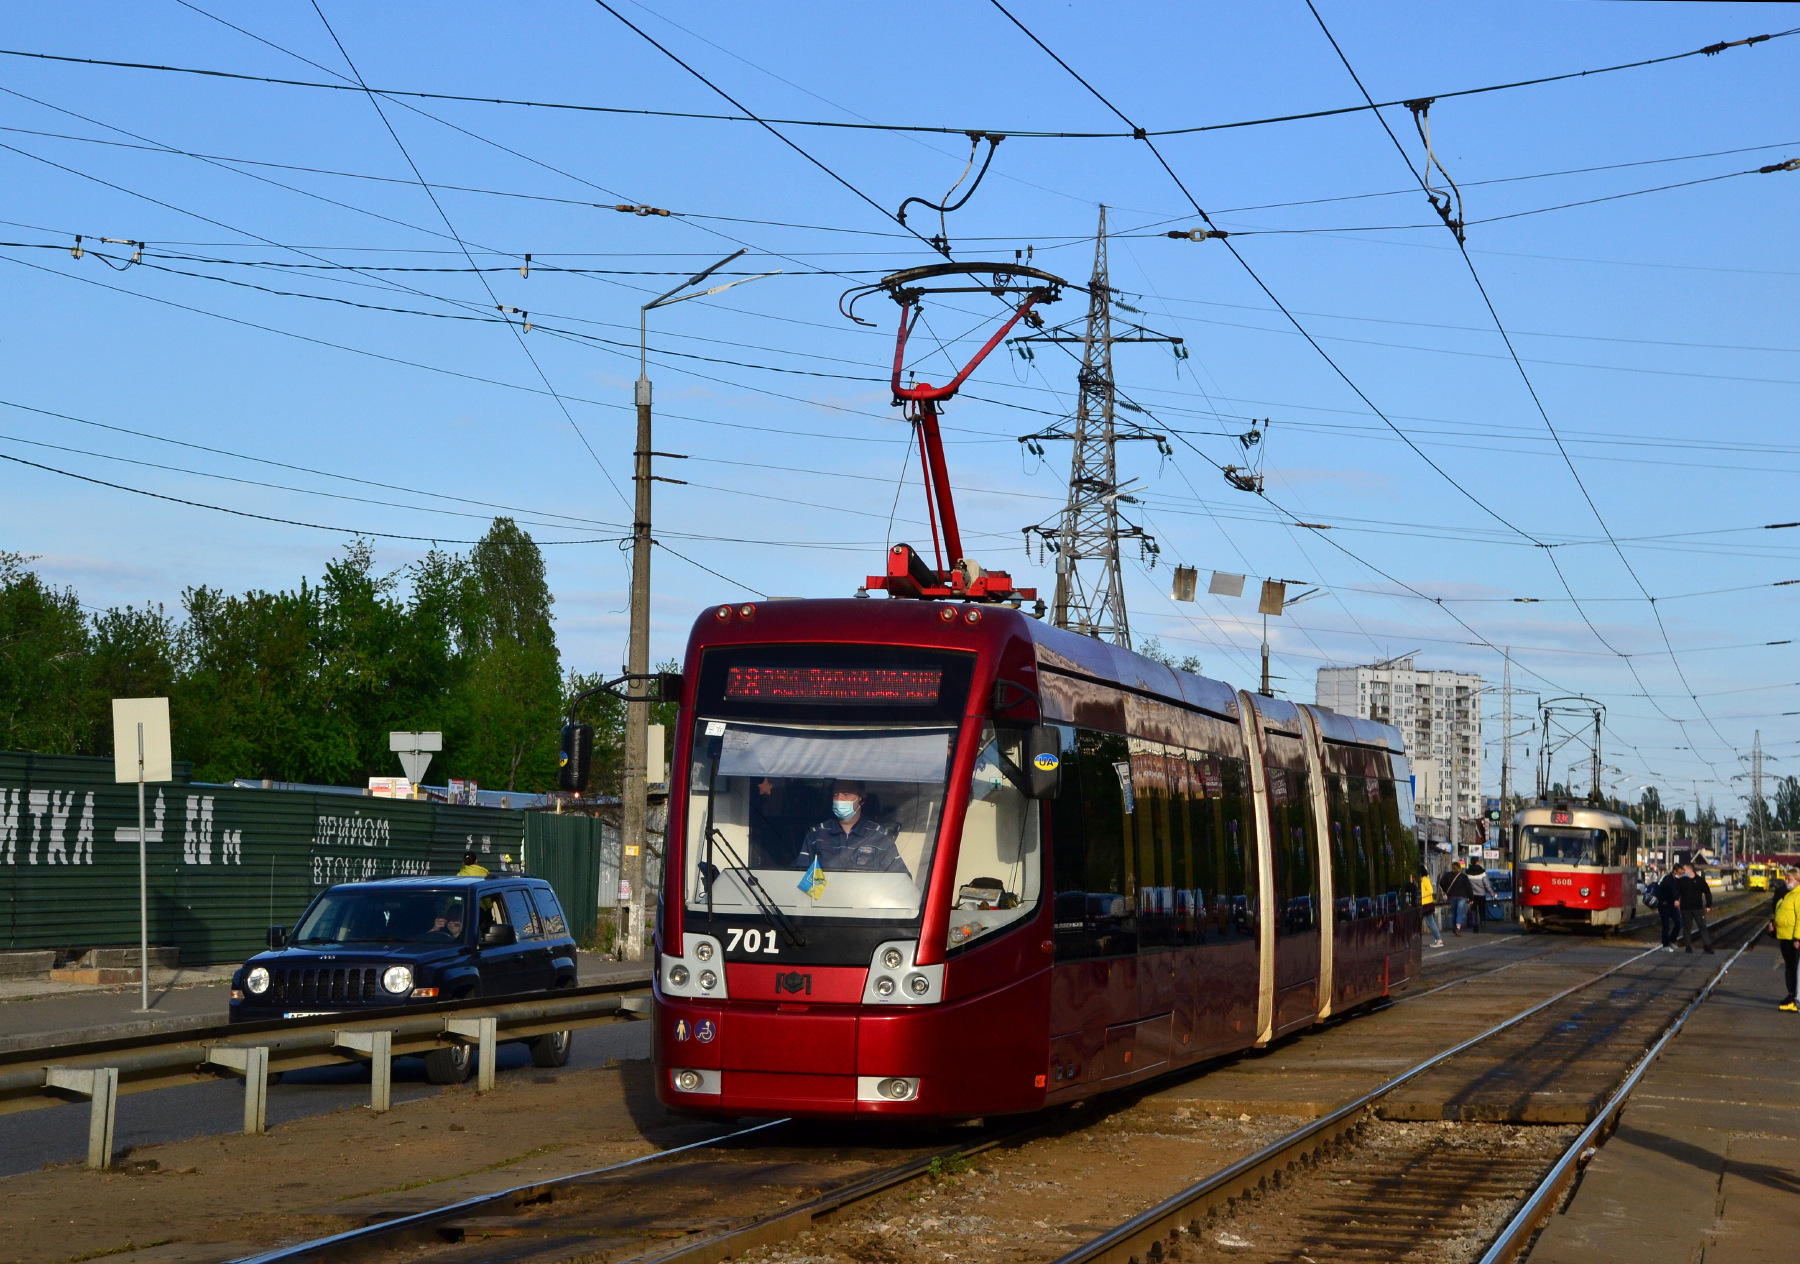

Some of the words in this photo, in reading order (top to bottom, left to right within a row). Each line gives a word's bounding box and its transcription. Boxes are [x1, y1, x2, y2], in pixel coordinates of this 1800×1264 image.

[1039, 757, 1053, 766] UA
[316, 810, 390, 847] ПРИЙОМ
[726, 928, 780, 954] 701
